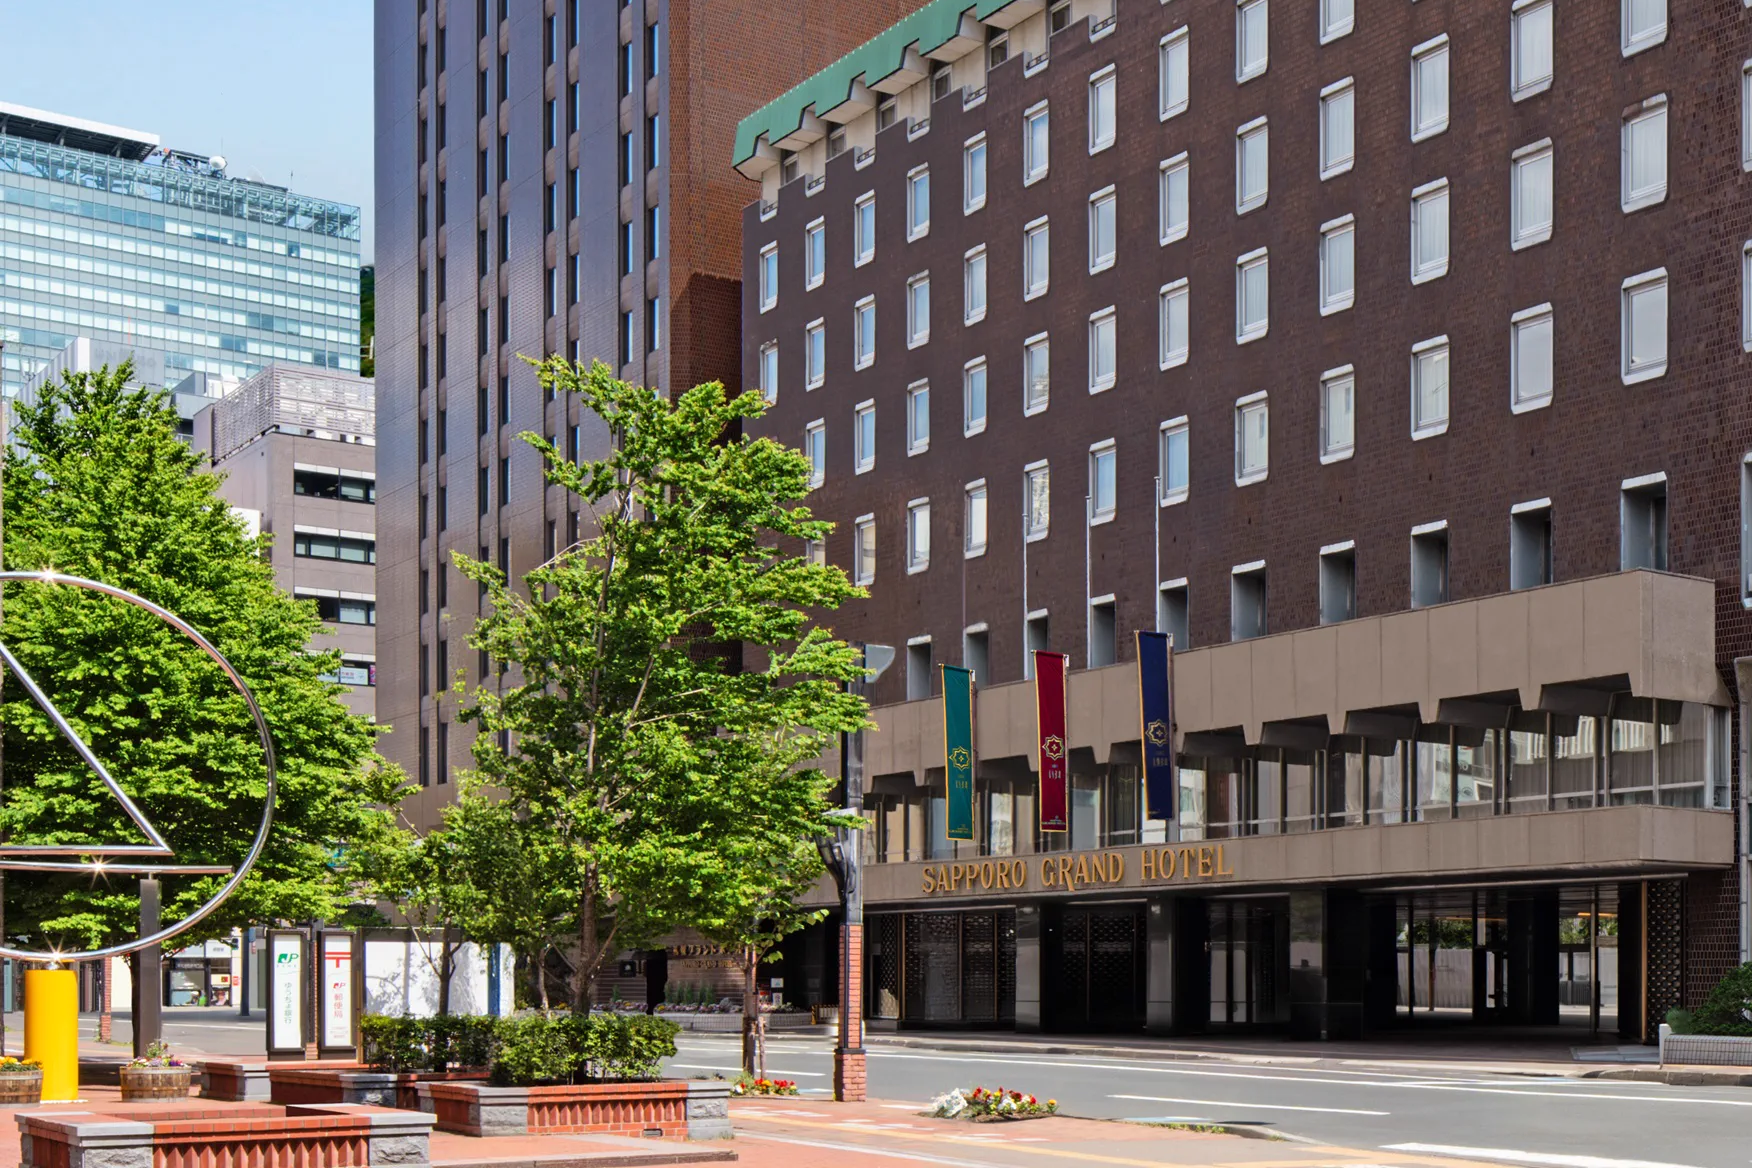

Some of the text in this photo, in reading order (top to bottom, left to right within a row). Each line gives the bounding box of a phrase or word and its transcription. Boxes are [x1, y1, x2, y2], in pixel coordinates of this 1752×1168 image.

[922, 844, 1234, 893] SAPPORO GRAND HOTEL
